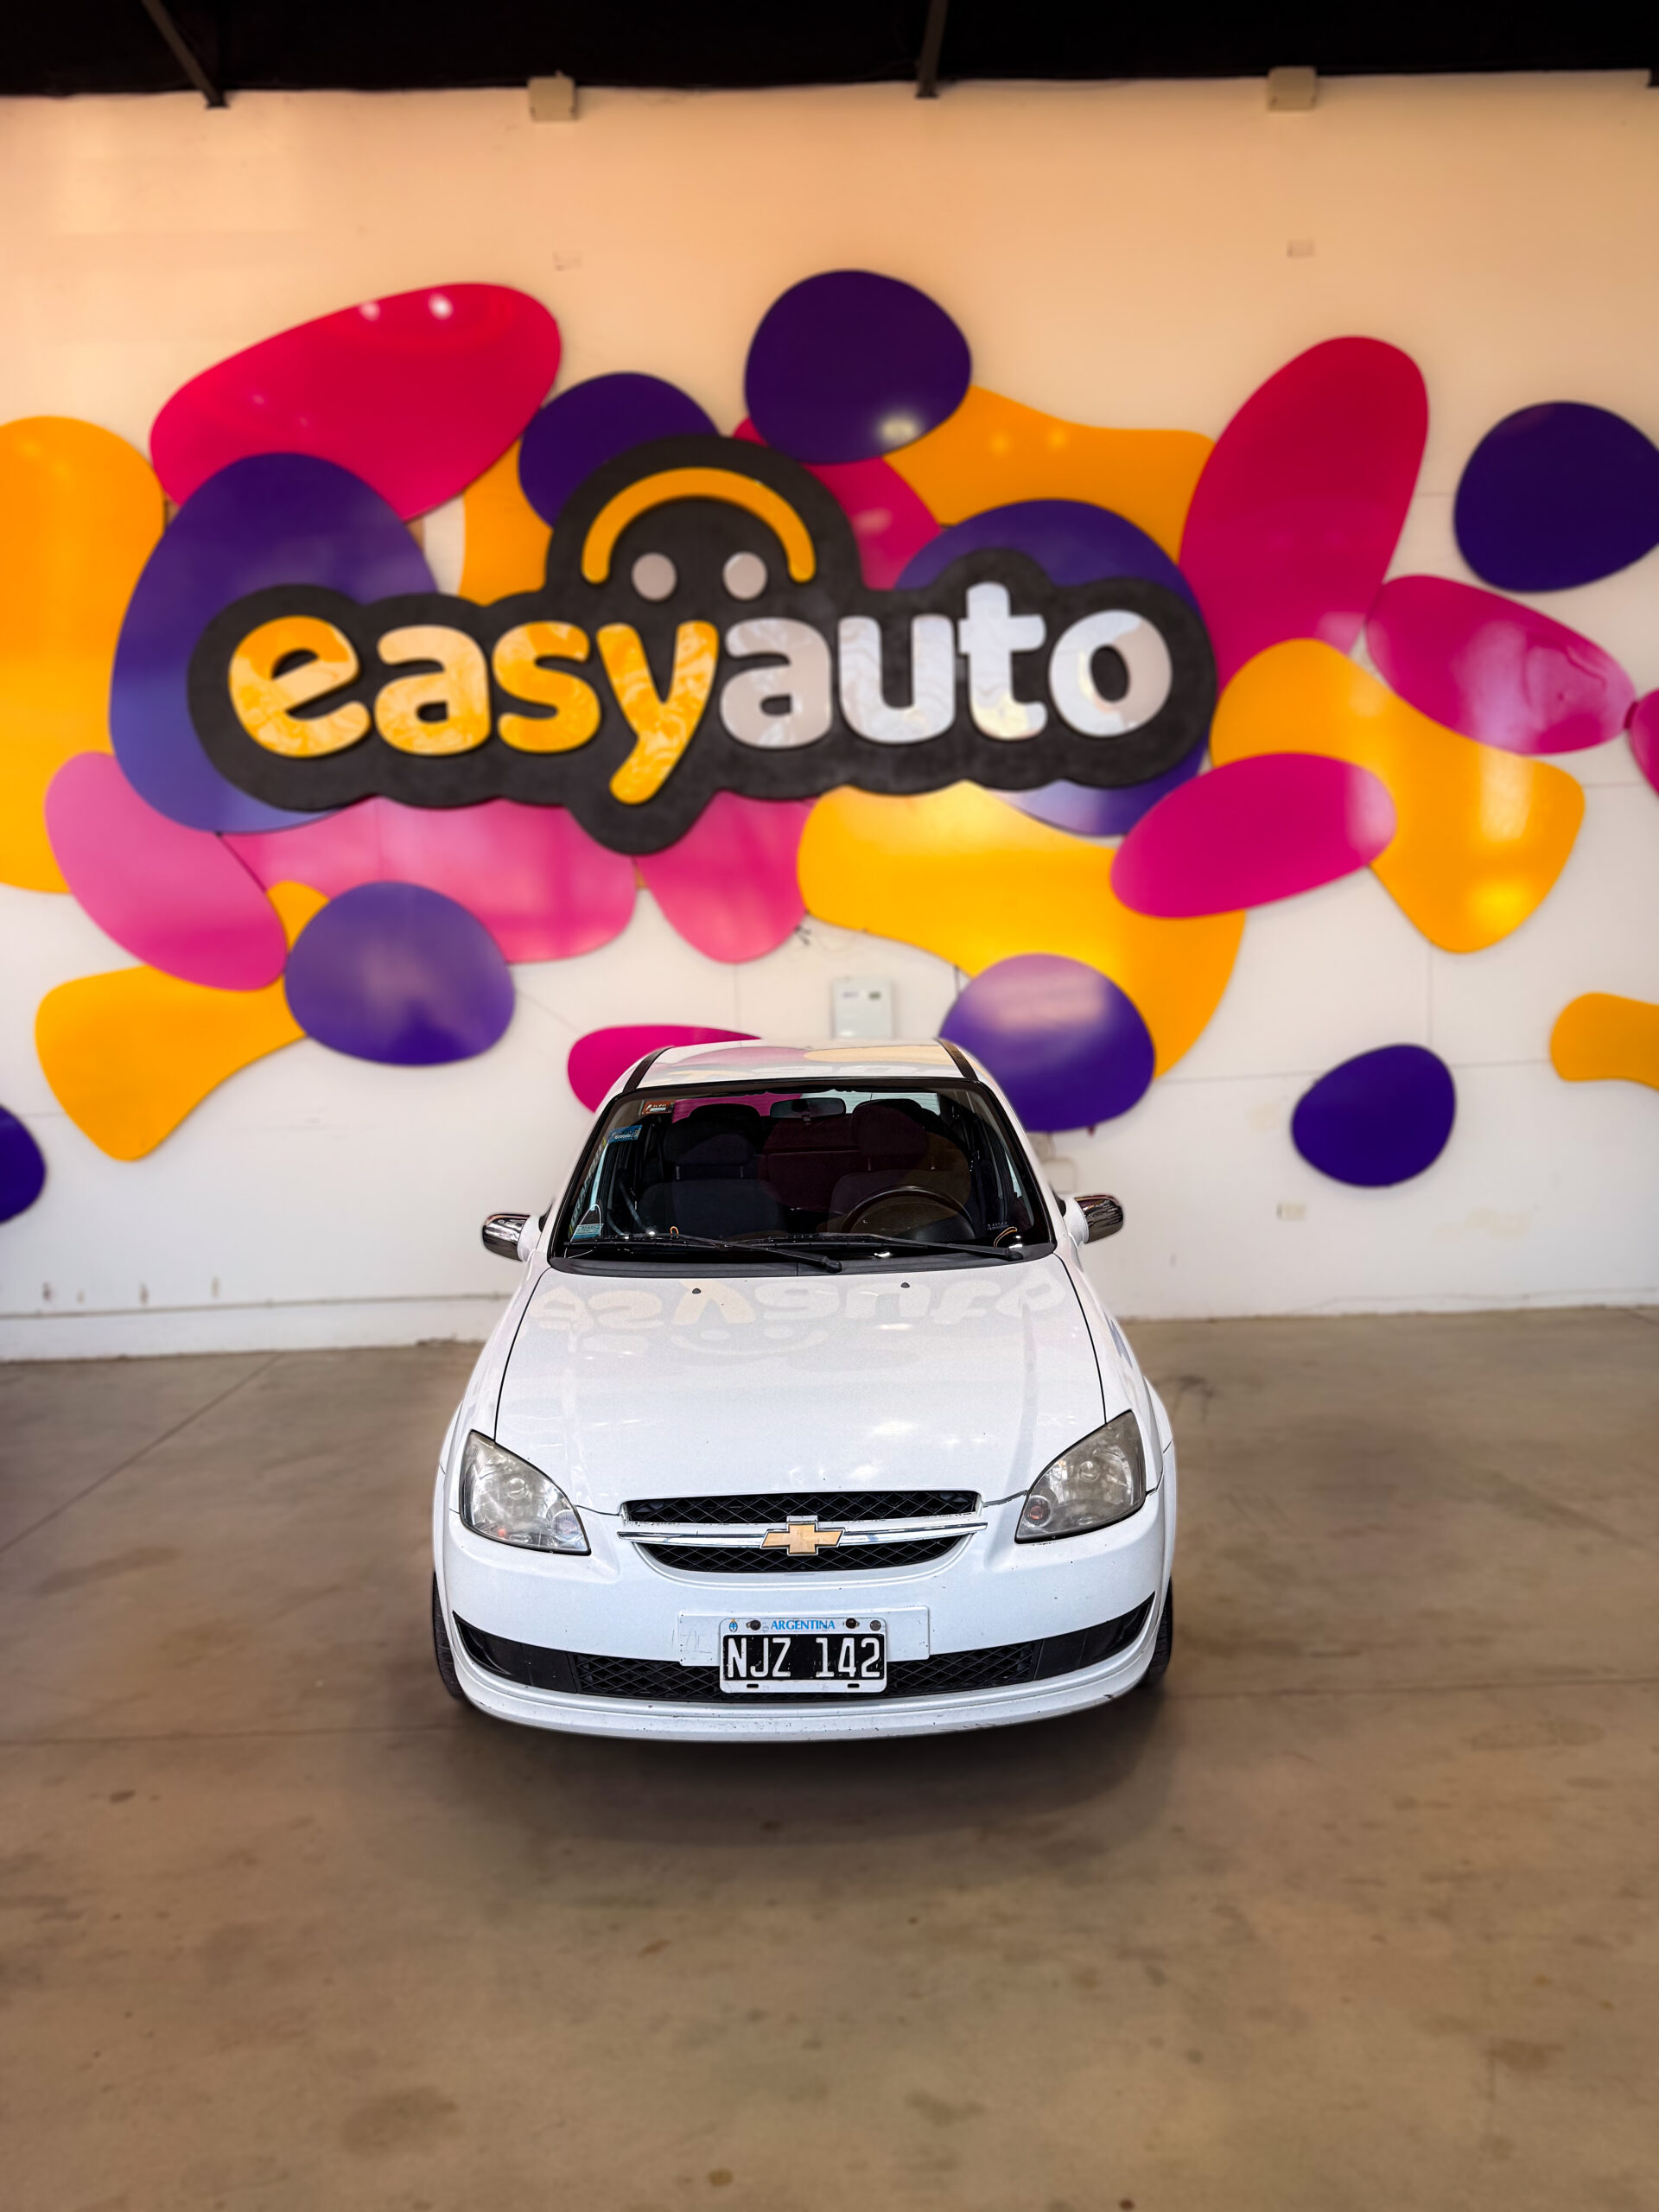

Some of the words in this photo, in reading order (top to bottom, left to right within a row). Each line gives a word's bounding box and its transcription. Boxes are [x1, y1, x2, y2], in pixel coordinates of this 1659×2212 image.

[228, 582, 1173, 804] easyauto
[770, 1619, 836, 1630] ARGENTINA
[728, 1637, 791, 1678] NJZ
[816, 1637, 880, 1677] 142
